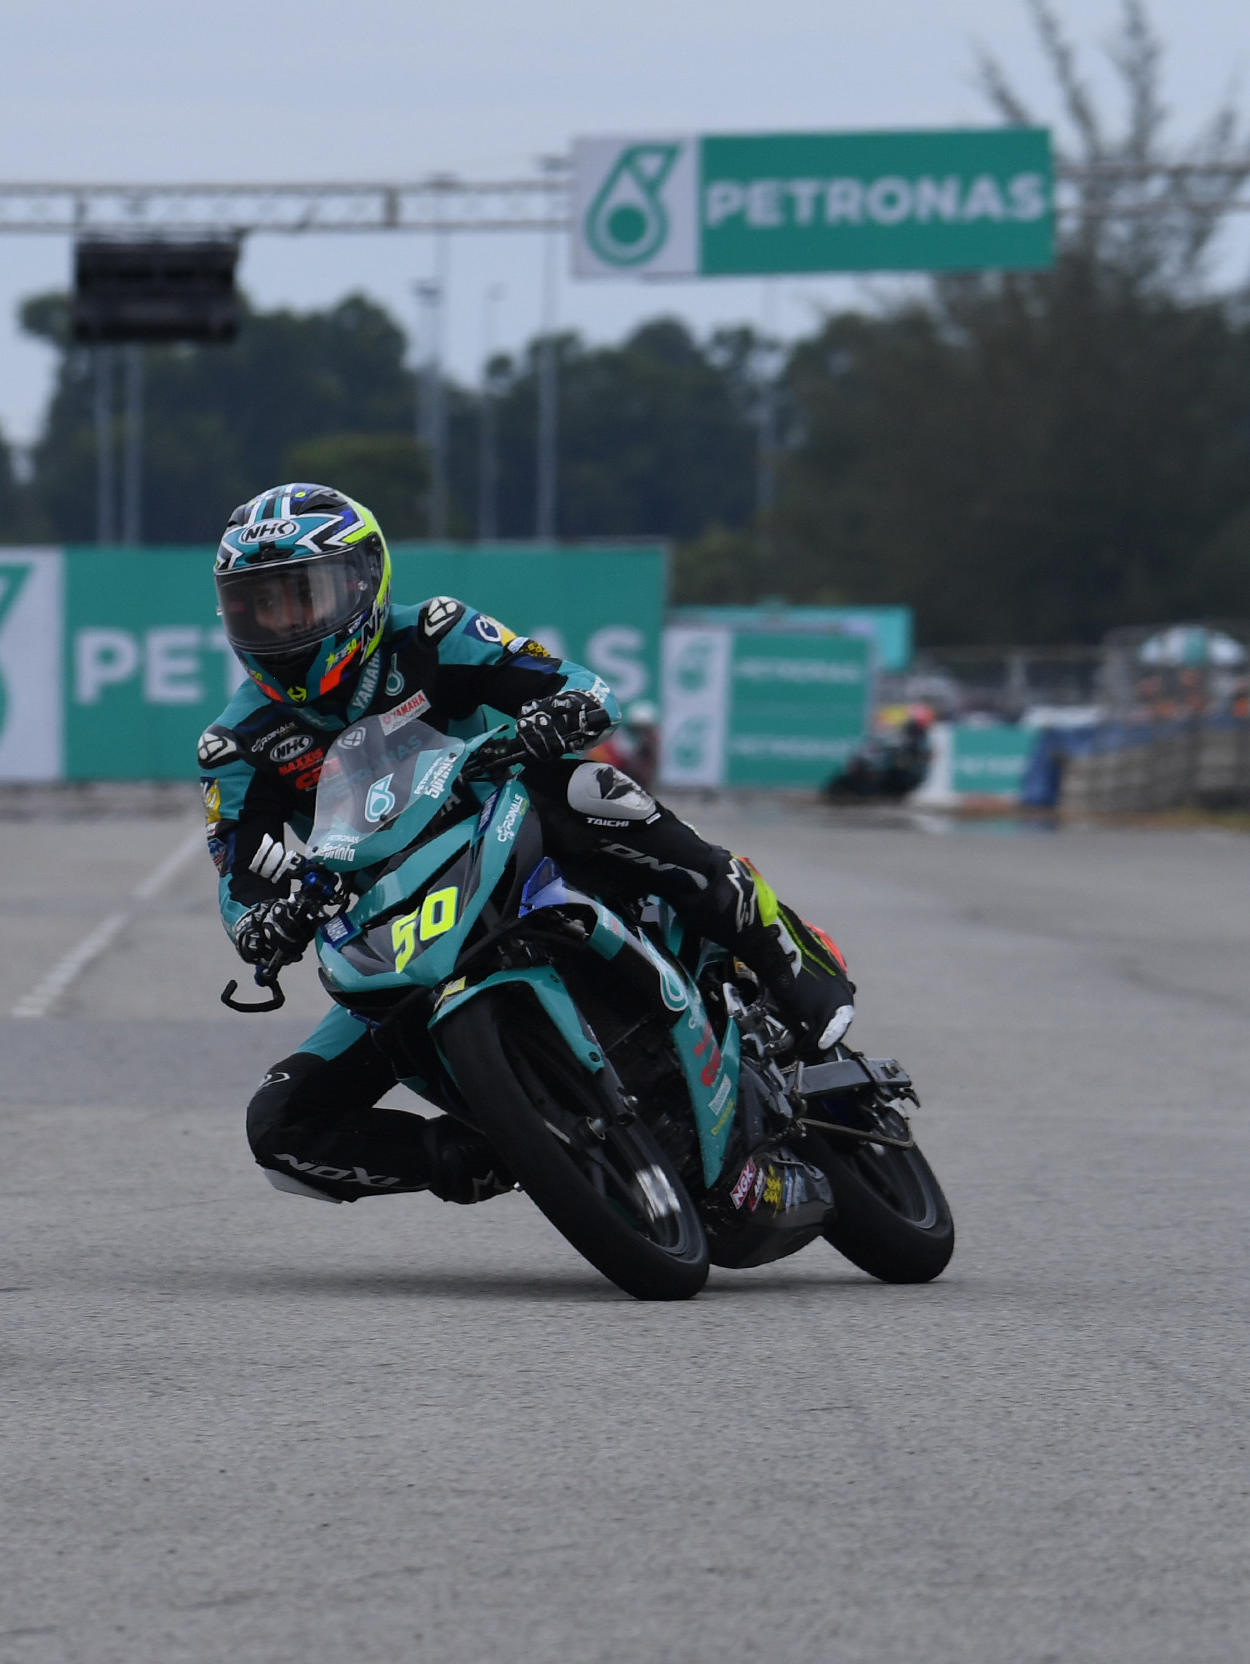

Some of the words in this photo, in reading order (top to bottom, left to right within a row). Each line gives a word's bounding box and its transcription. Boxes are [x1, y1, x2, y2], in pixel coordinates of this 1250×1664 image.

[706, 173, 1045, 228] PETRONAS
[393, 694, 425, 718] YAMAHA
[276, 737, 307, 759] NHK
[586, 817, 630, 828] TAICHI
[391, 886, 458, 973] 50
[273, 1153, 400, 1187] IXON
[733, 1163, 754, 1206] NGK
